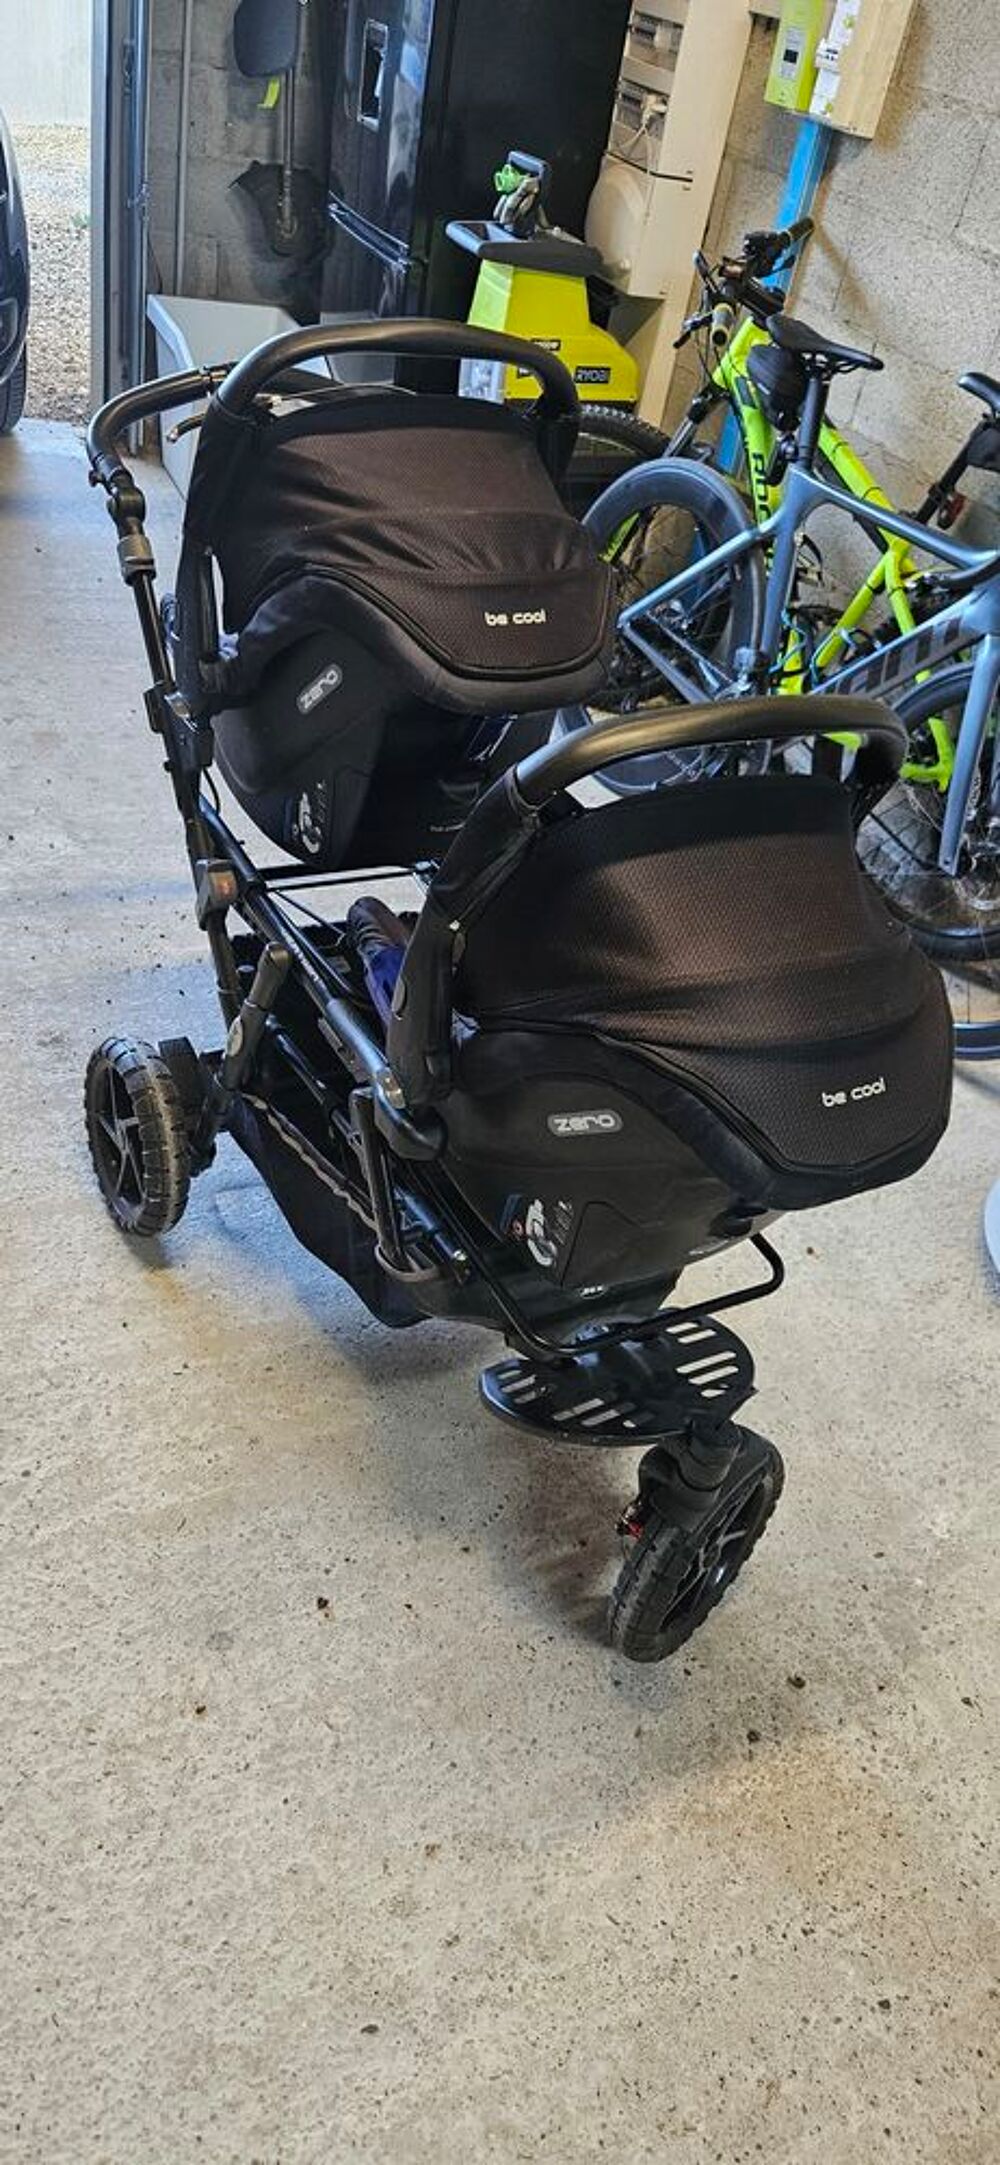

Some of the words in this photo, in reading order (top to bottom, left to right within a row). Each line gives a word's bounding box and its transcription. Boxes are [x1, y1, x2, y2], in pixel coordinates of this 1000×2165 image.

[484, 611, 508, 626] be
[512, 608, 546, 624] cool
[822, 1091, 847, 1107] be
[850, 1076, 886, 1100] cool
